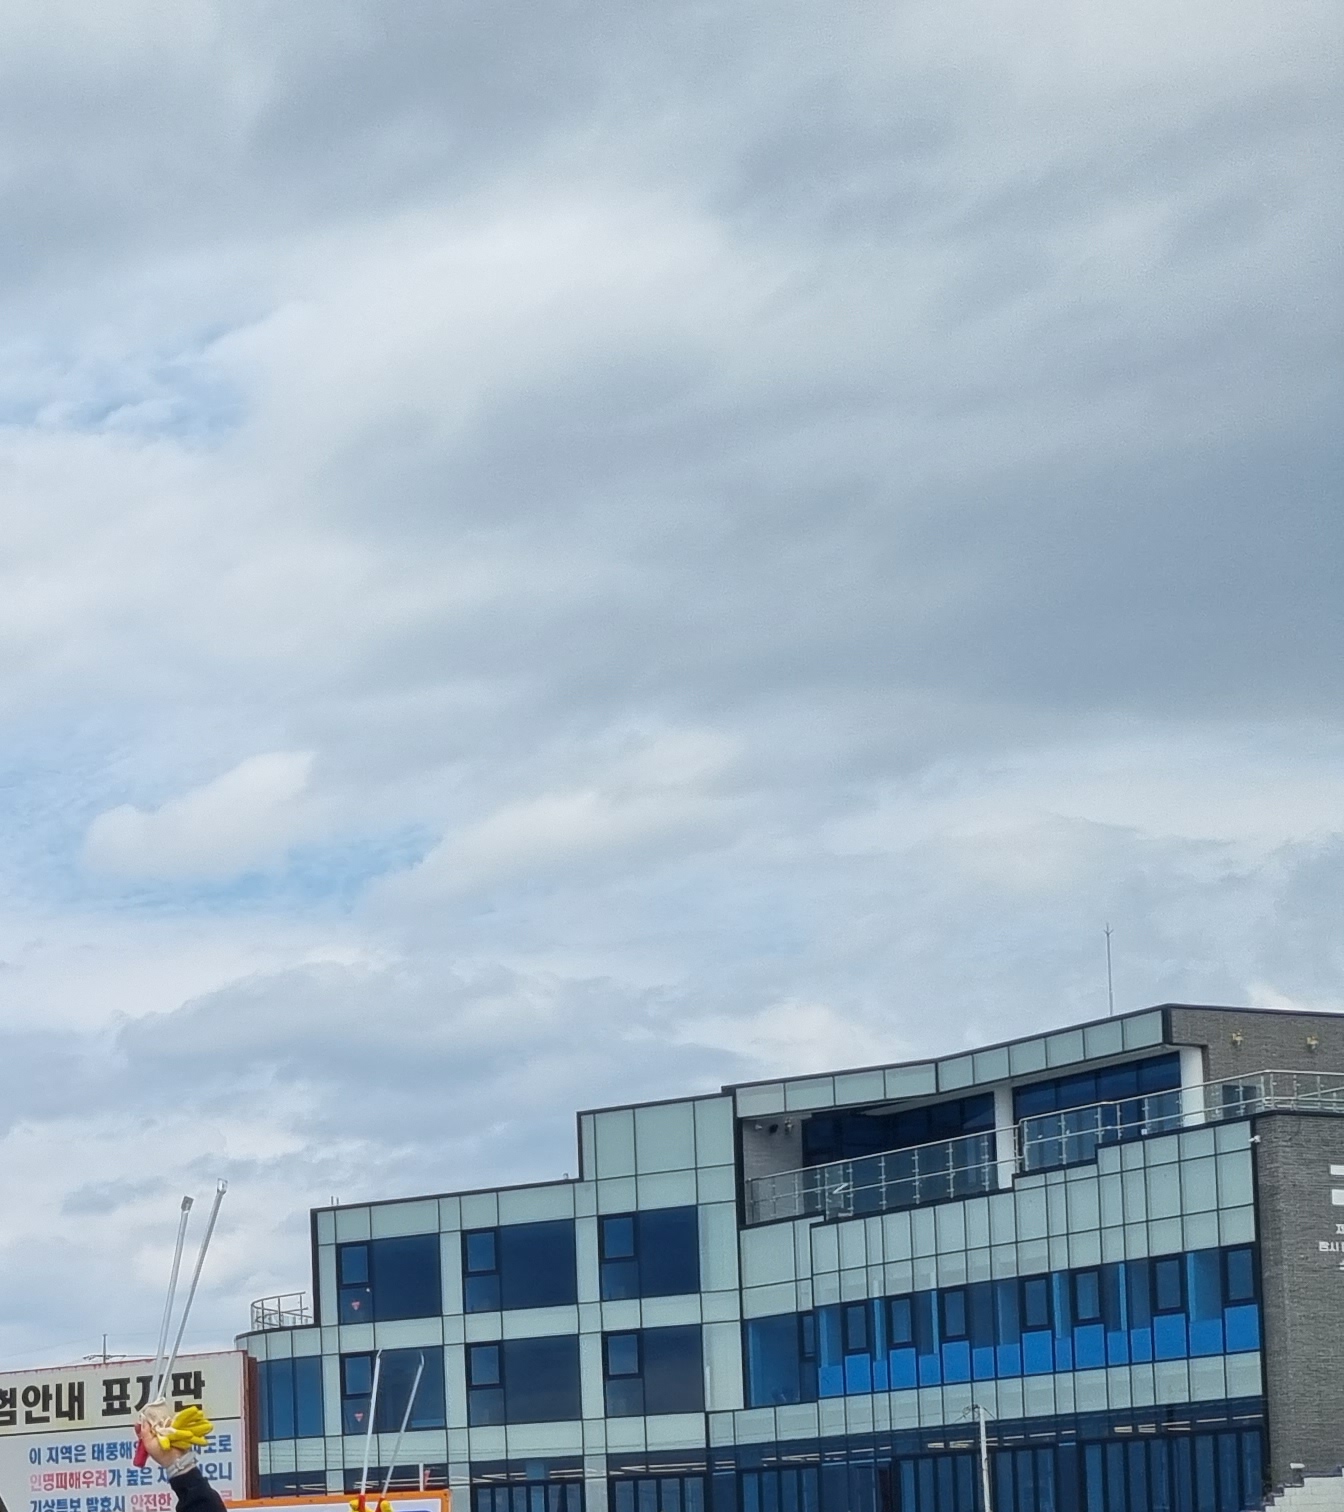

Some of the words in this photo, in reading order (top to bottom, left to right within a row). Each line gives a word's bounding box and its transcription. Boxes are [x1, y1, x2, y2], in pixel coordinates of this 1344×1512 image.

[29, 1448, 42, 1465] 이
[46, 1444, 86, 1465] 지역은
[91, 1440, 136, 1462] 태풍해
[29, 1469, 122, 1492] 인명피해우려가
[126, 1467, 152, 1487] 높은
[130, 1493, 172, 1512] 안전한
